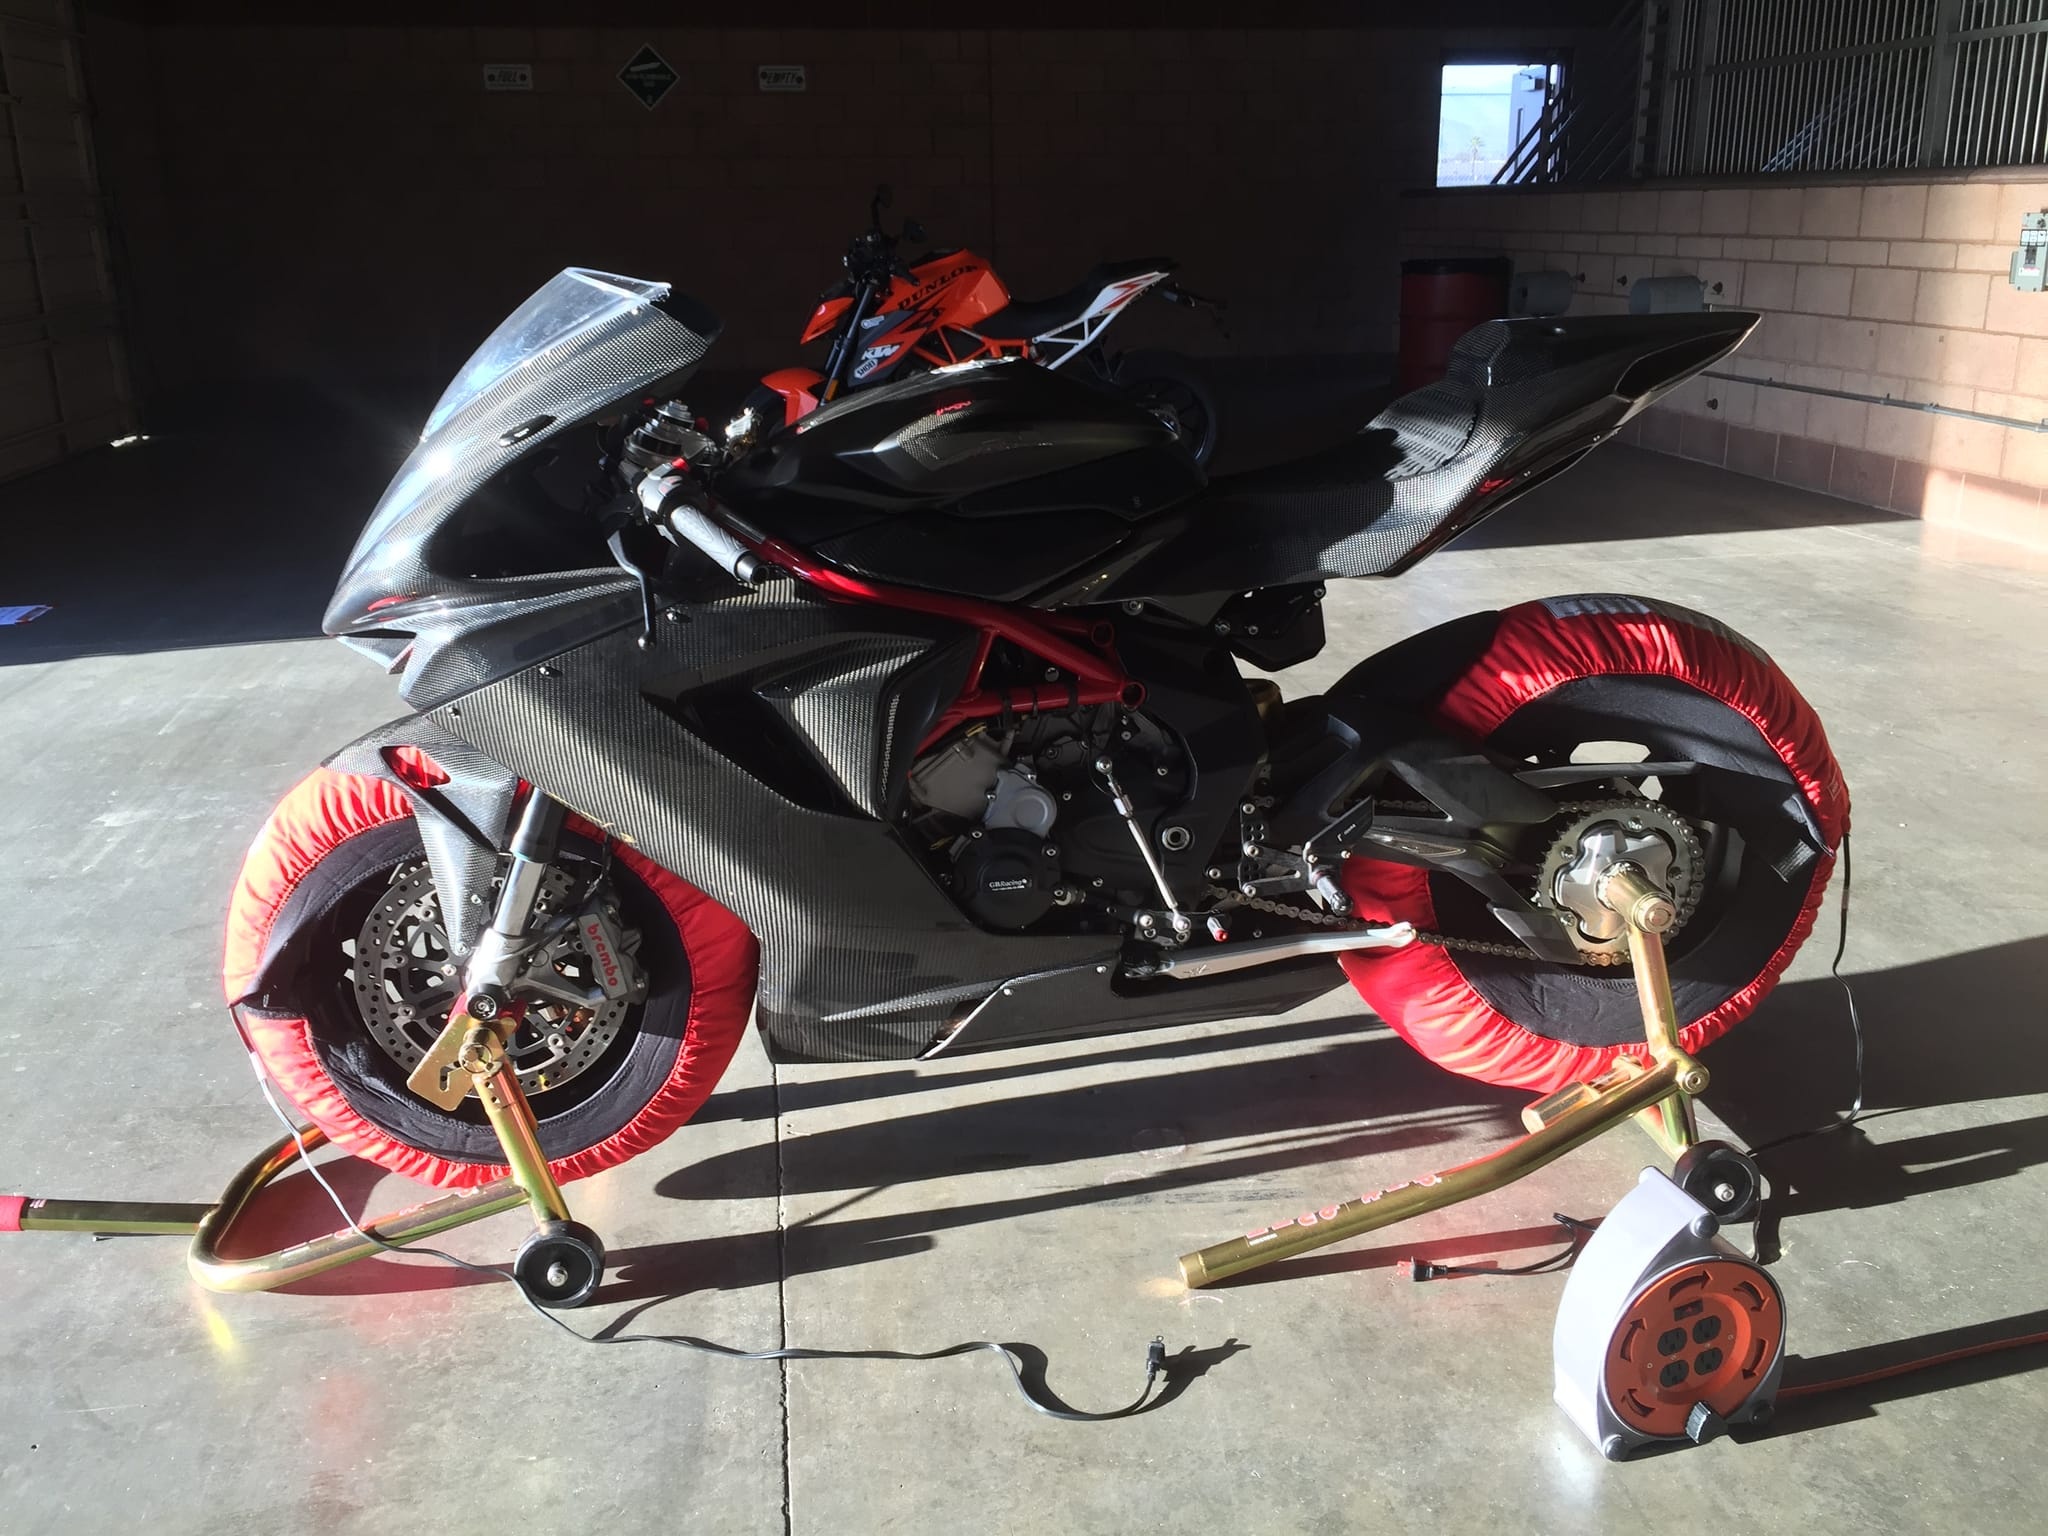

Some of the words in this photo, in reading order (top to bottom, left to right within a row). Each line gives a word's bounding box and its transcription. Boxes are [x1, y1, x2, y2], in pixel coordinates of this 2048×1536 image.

[767, 72, 797, 84] EMPTY
[897, 264, 978, 310] DUNLOP
[860, 344, 901, 361] KTM
[587, 922, 618, 987] brembo
